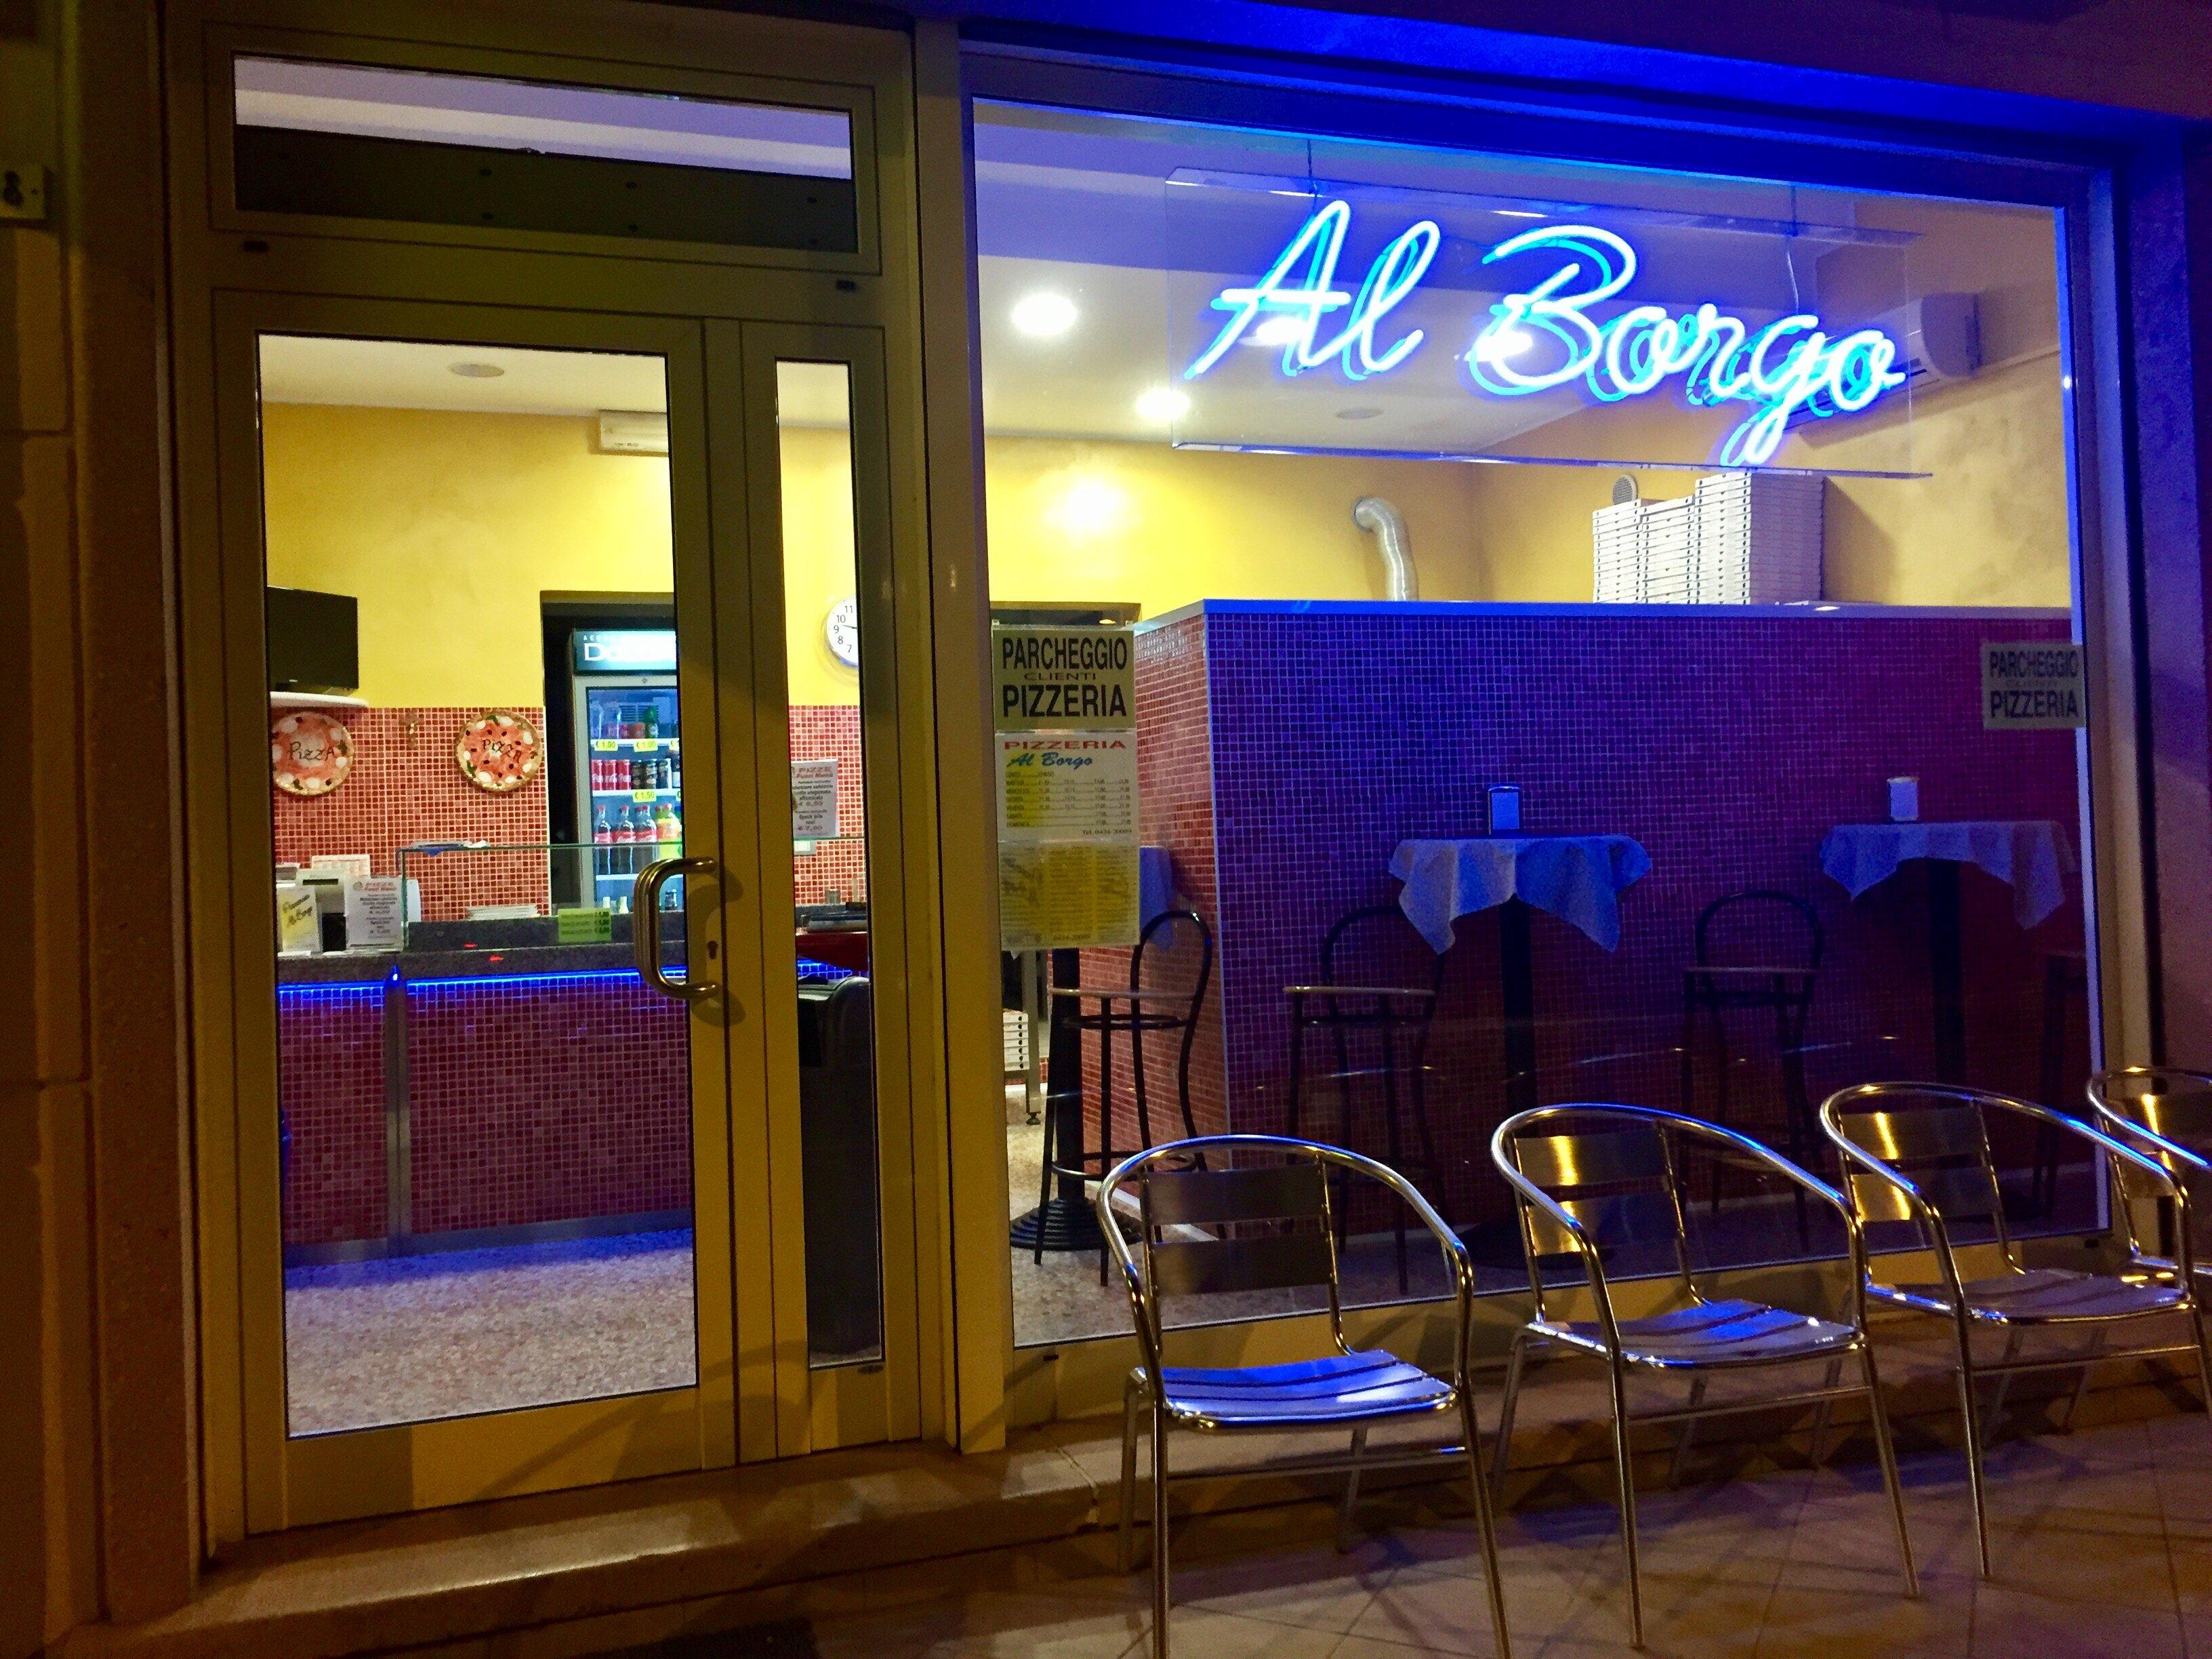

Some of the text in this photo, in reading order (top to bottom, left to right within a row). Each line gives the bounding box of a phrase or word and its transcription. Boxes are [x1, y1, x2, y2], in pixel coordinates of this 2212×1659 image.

[1185, 199, 1906, 466] Al Borgo
[844, 605, 853, 613] 11
[836, 614, 846, 623] 10
[834, 624, 840, 634] 9
[838, 635, 844, 645] 8
[847, 644, 853, 653] 7
[1002, 637, 1127, 670] PARCHEGGIO
[1989, 651, 2078, 677] PARCHEGGIO
[1024, 672, 1096, 680] CLIENTI
[1002, 684, 1127, 718] PIZZERIA
[1990, 690, 2080, 718] PIZZERIA
[1004, 740, 1126, 750] PIZZERIA
[1006, 752, 1093, 770] Al Borgo
